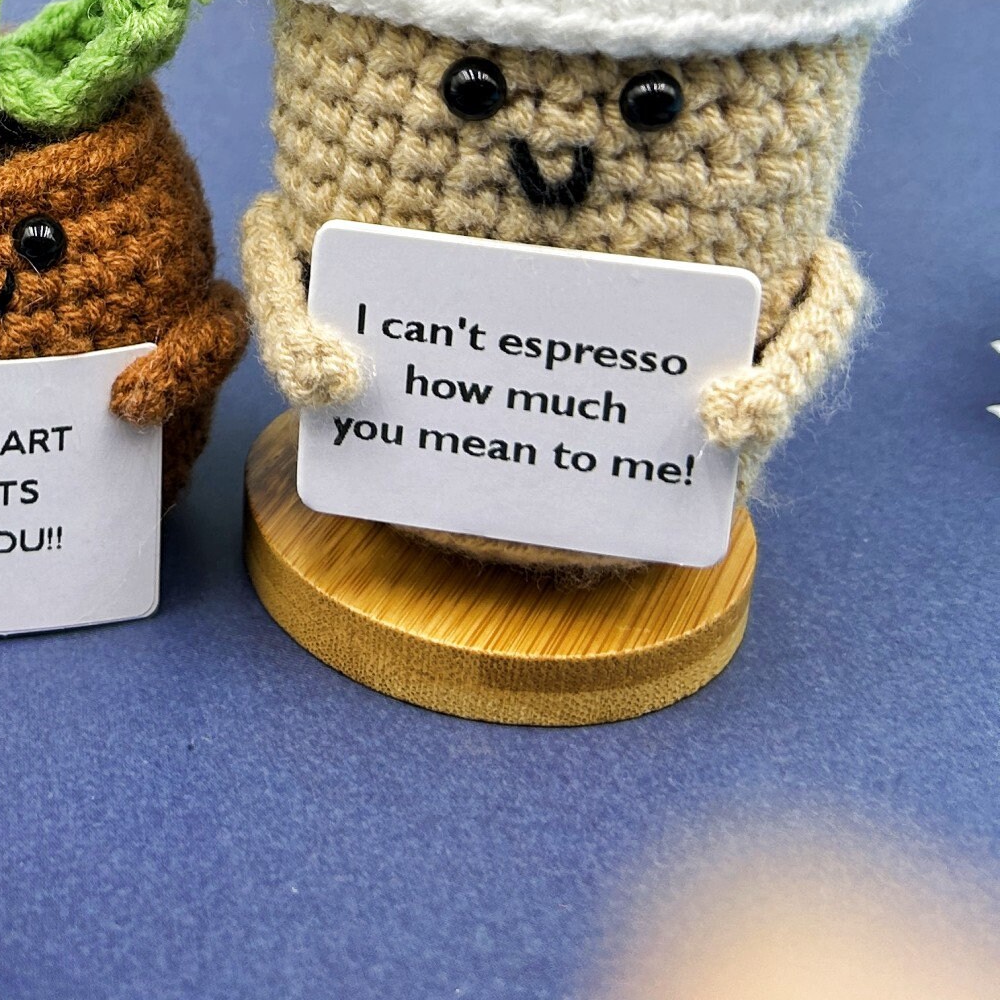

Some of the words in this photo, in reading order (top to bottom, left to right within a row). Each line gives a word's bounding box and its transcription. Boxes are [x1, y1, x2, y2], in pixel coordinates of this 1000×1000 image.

[357, 303, 367, 335] I
[381, 316, 486, 351] can't
[498, 334, 688, 376] espresso
[405, 363, 493, 405] how
[507, 388, 627, 424] much
[332, 415, 404, 446] you
[418, 428, 537, 465] mean
[553, 442, 597, 473] to
[611, 454, 695, 486] me!
